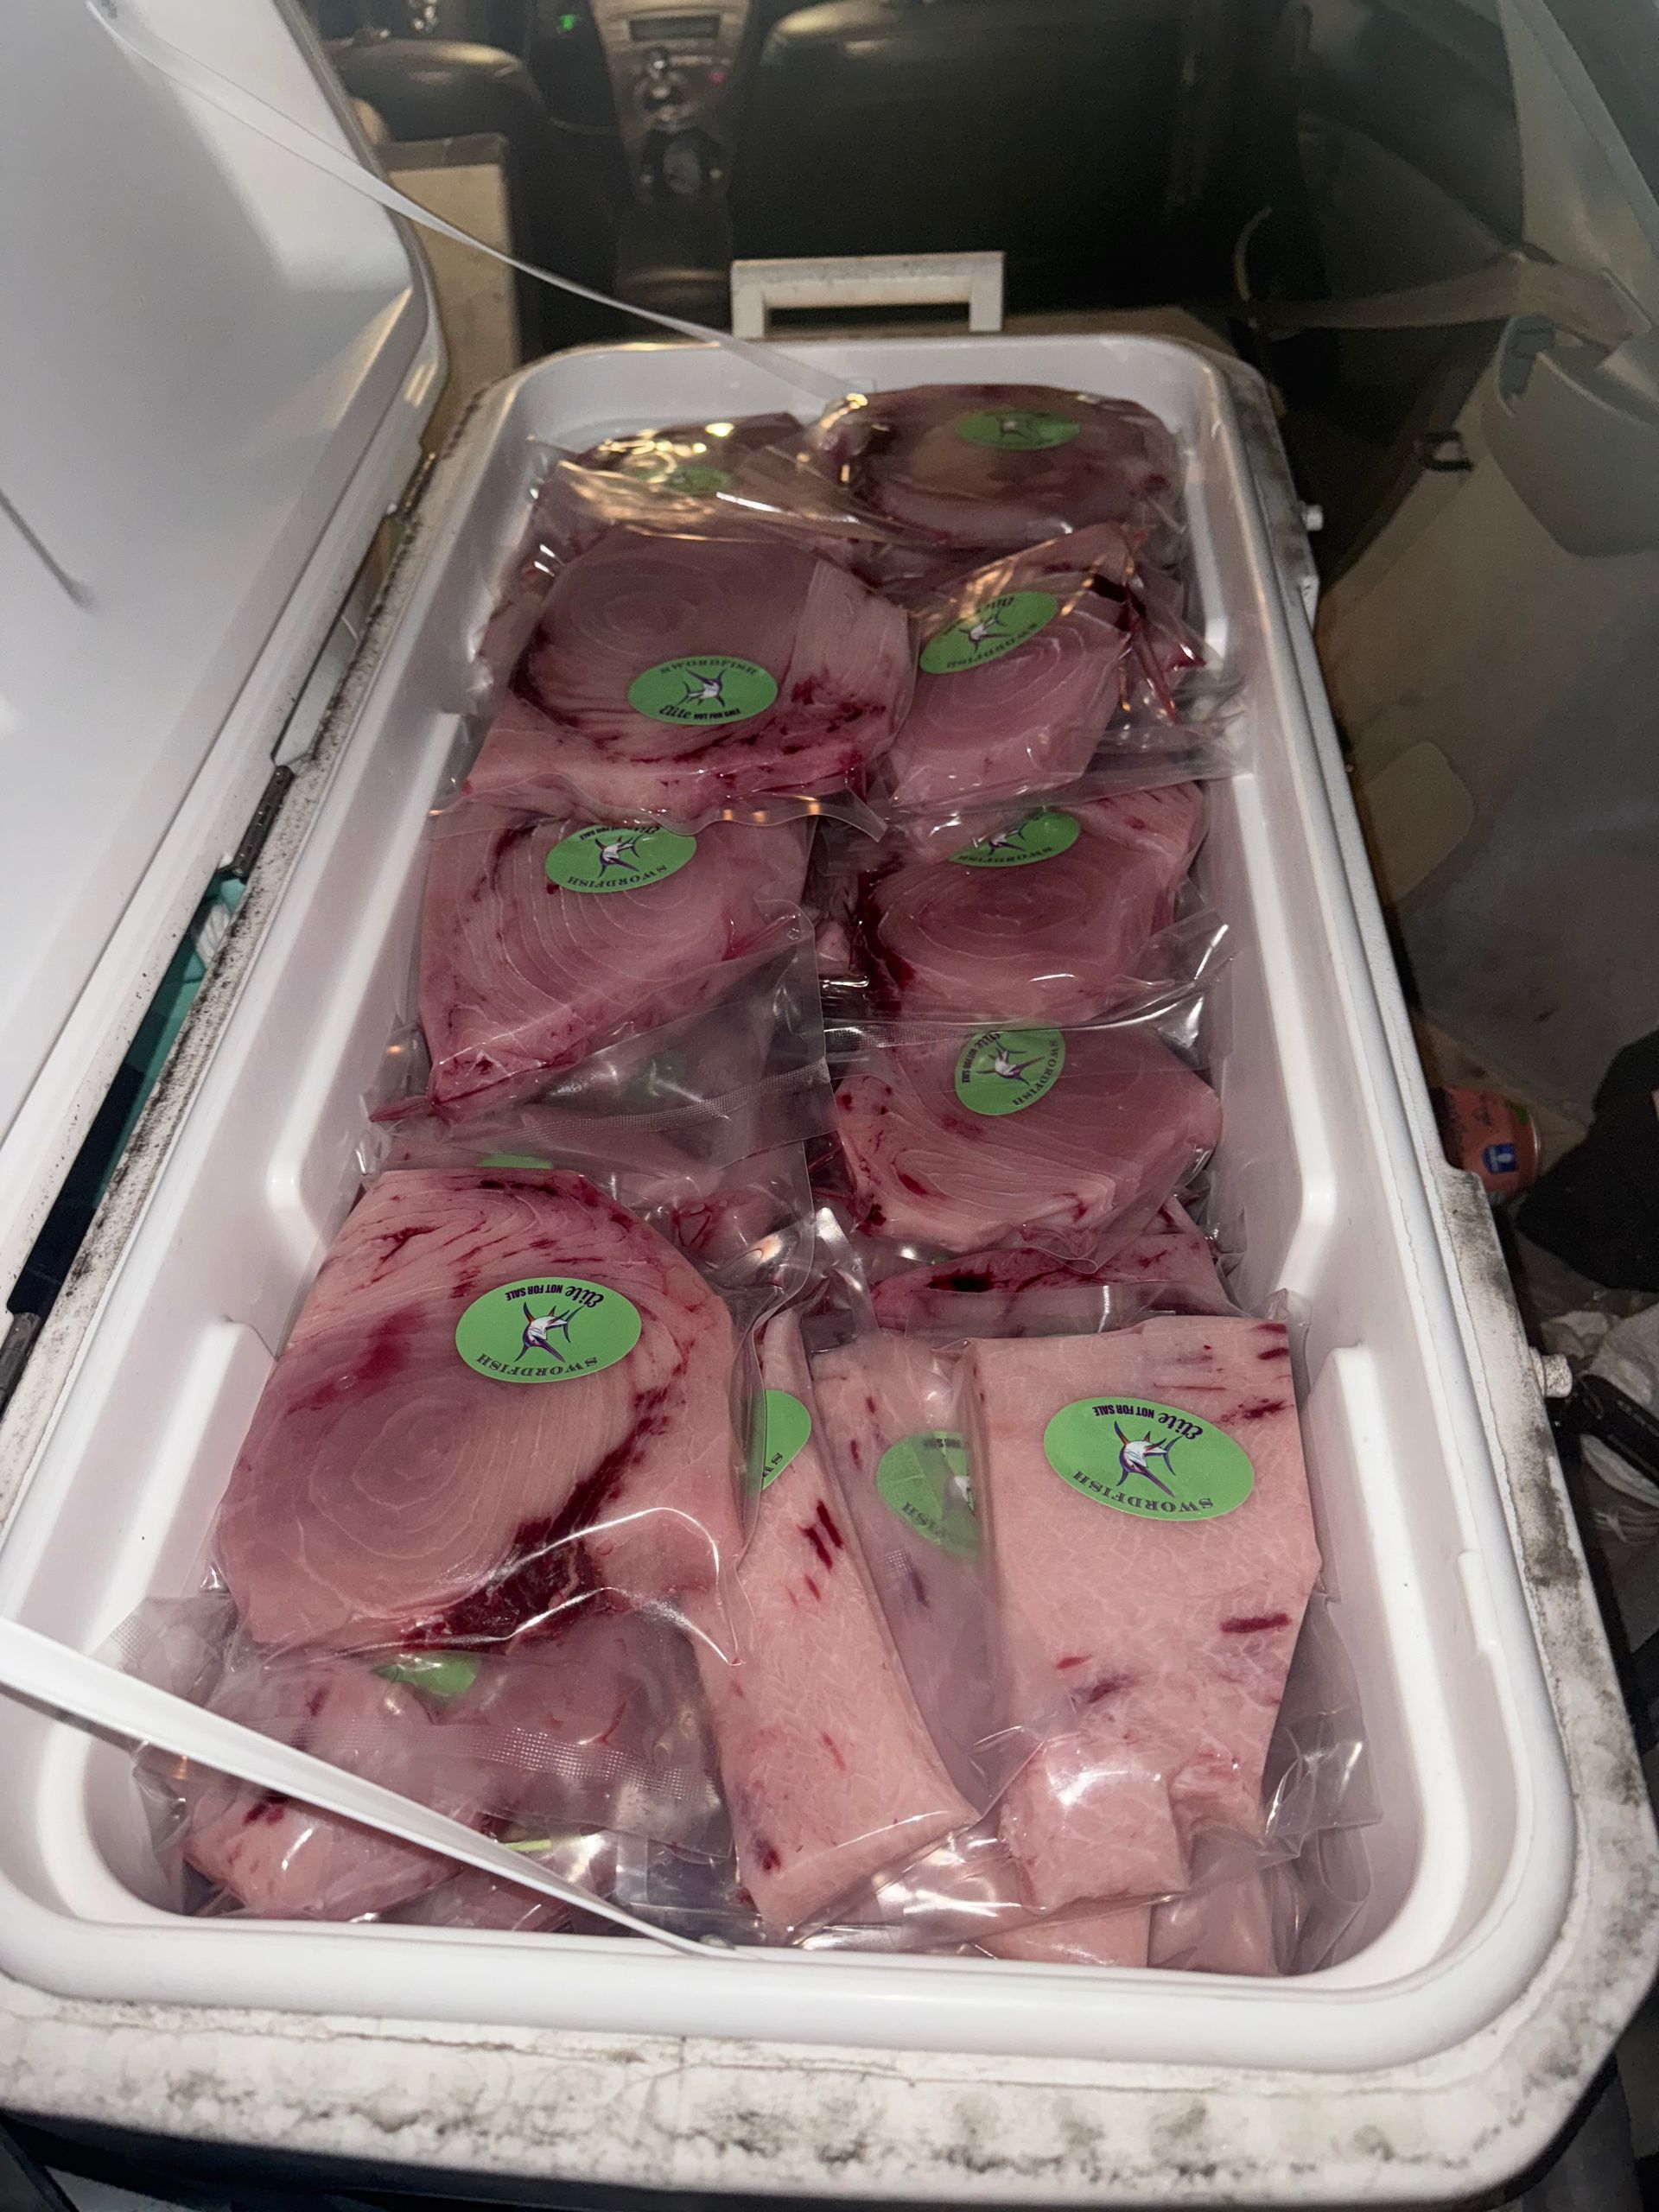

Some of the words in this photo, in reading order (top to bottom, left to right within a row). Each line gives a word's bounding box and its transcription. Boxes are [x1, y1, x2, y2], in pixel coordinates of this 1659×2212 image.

[659, 705, 692, 720] Elite
[567, 864, 667, 888] SWORDFISH
[1012, 1039, 1058, 1106] SWORDFISH
[505, 1287, 526, 1301] SALE
[527, 1284, 544, 1294] FOR
[544, 1284, 563, 1294] NOT
[564, 1285, 604, 1308] Elite
[476, 1352, 598, 1377] SWORDFISH
[1091, 1404, 1116, 1416] SALE
[1116, 1404, 1135, 1415] FOR
[1135, 1408, 1154, 1420] NOT
[1158, 1413, 1204, 1440] Elite
[1071, 1471, 1214, 1513] SWORDFISH
